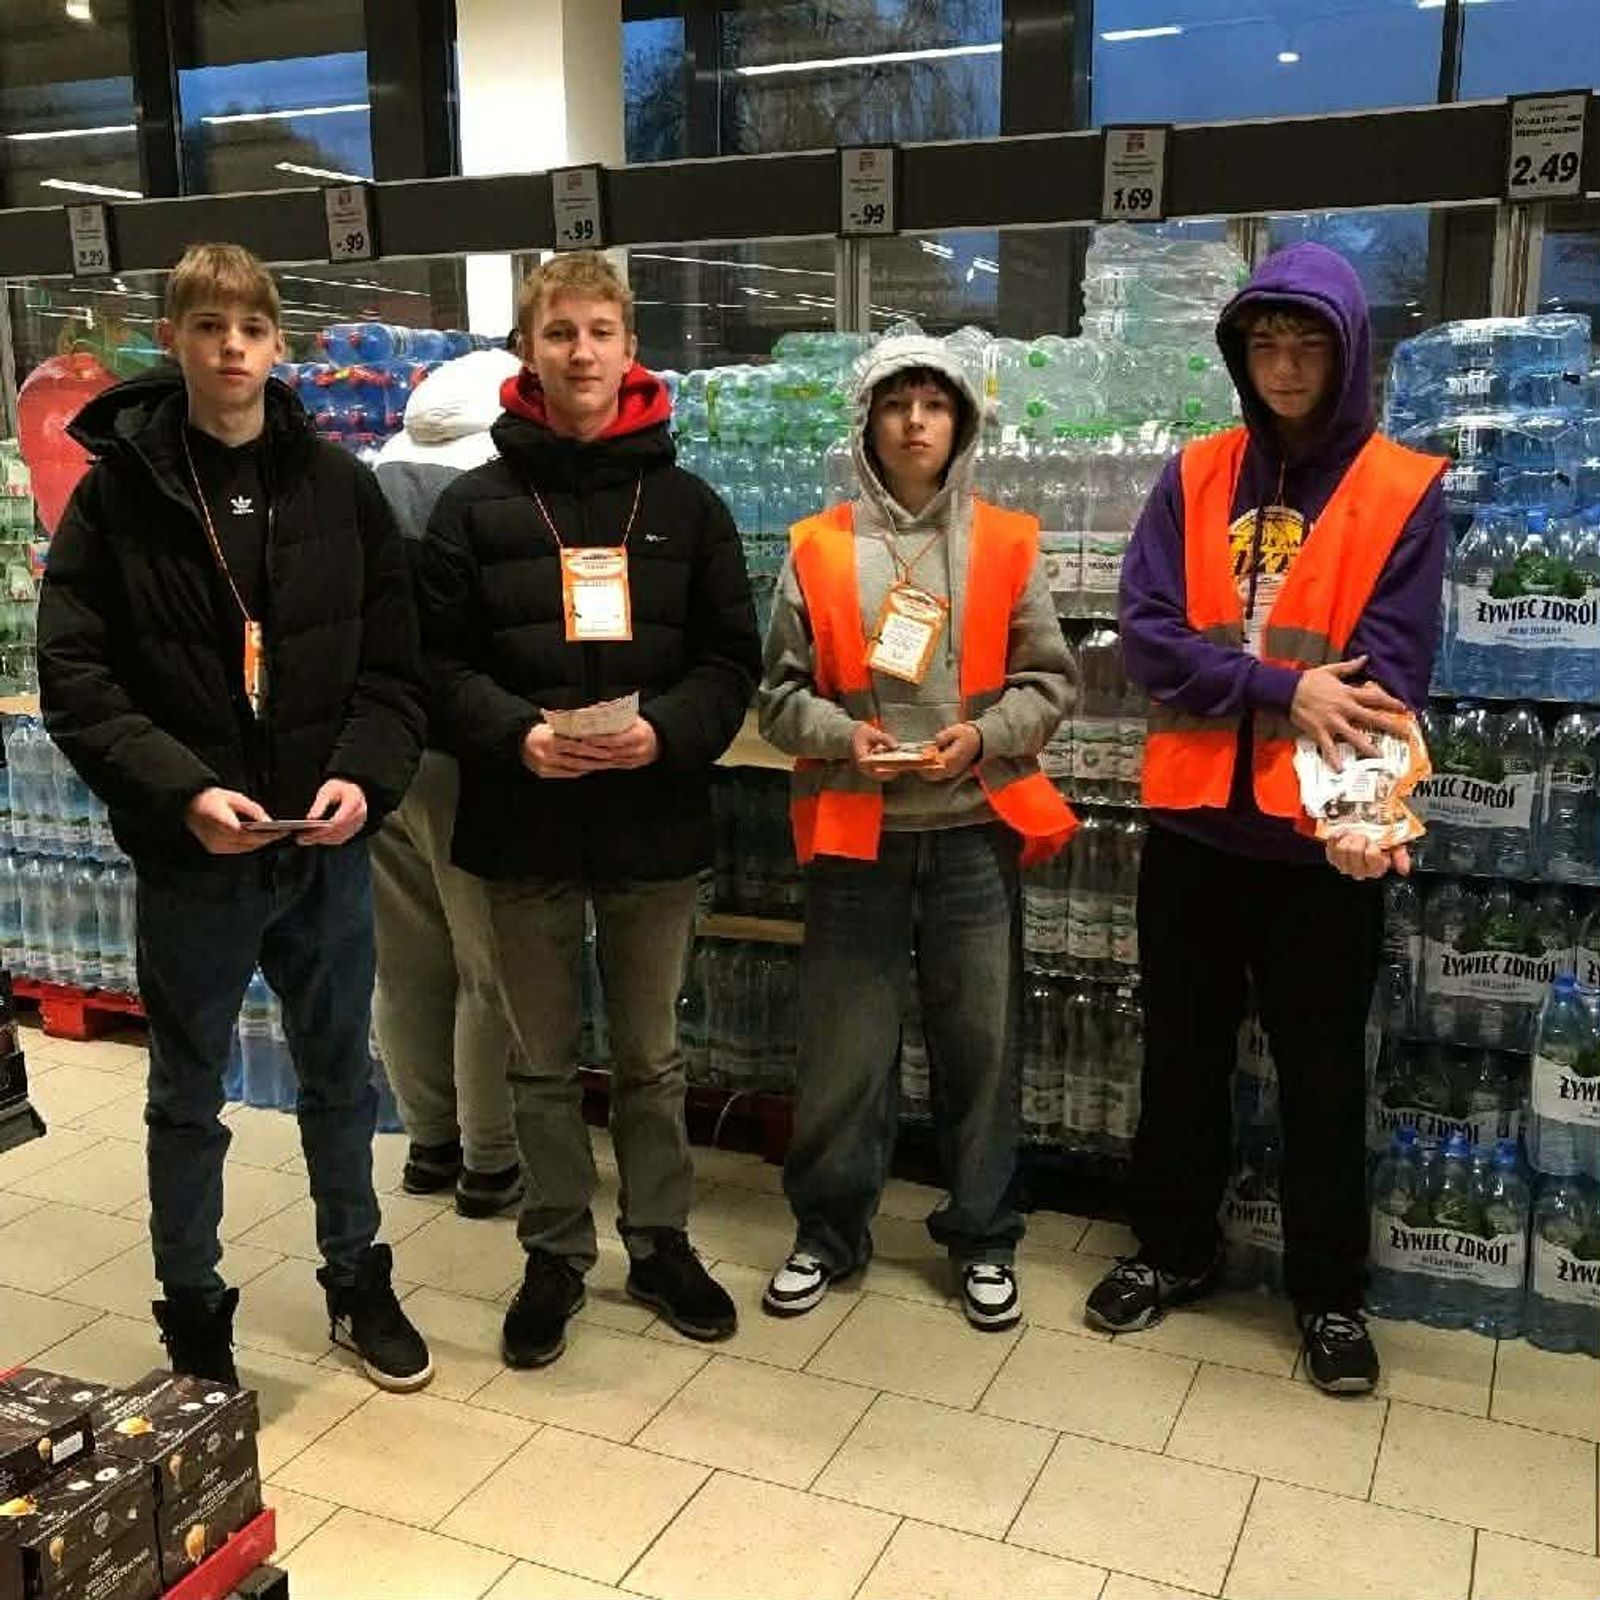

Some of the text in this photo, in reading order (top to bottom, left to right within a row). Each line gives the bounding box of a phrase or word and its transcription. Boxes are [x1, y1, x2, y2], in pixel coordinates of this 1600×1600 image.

[1511, 151, 1579, 185] 2.49
[1113, 188, 1153, 211] 1.69
[1476, 599, 1538, 623] ŻYWIEC
[1441, 954, 1500, 977] ŻYWIEC
[1390, 1225, 1450, 1251] ŻYWIEC
